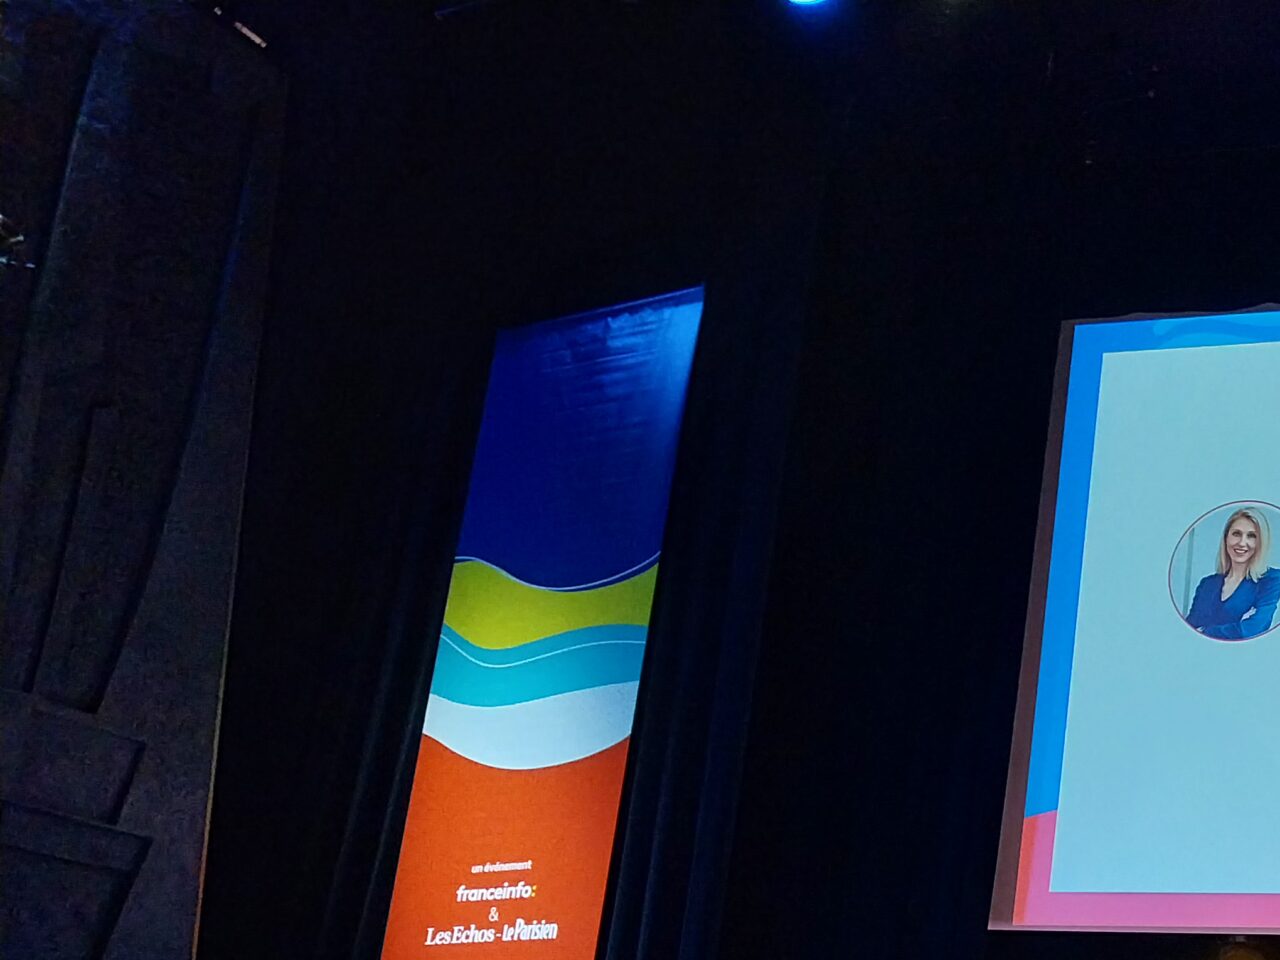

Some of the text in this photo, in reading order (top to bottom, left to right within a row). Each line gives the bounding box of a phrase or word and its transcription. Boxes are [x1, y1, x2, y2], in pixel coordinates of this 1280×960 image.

[471, 859, 533, 874] un événement
[456, 881, 538, 903] franceinfo:
[488, 906, 499, 922] &
